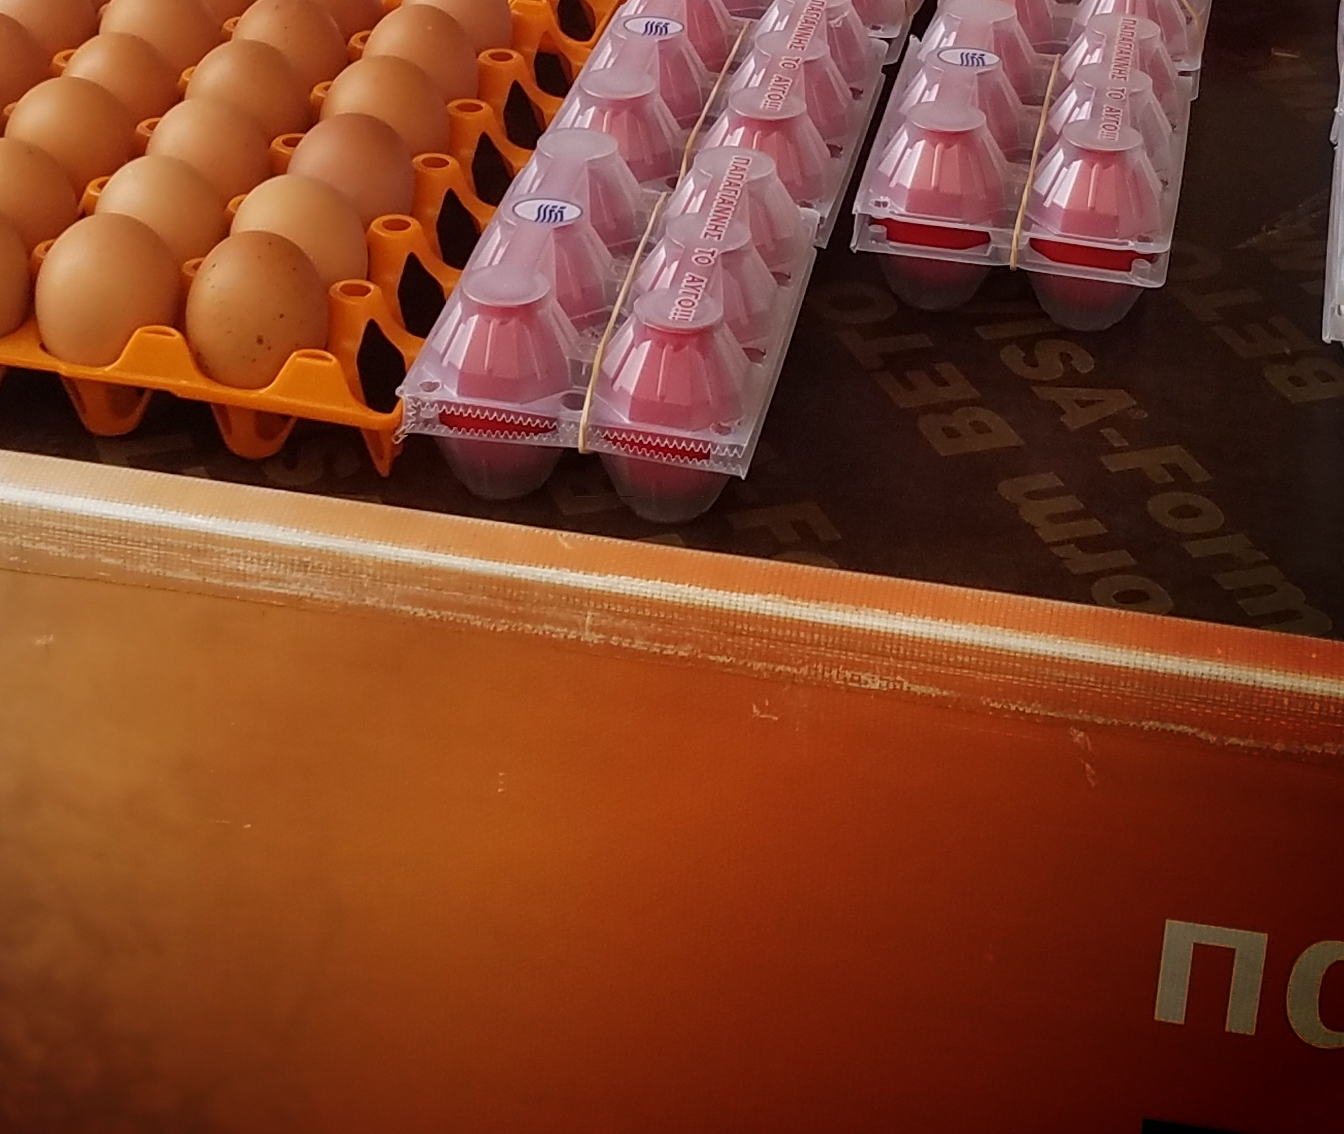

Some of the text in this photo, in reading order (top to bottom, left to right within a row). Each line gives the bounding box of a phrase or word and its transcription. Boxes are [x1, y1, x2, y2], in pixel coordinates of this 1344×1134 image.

[780, 56, 802, 70] ΤΟ
[1110, 17, 1137, 82] ΠΑΠΑΓΙΑΝΝΗΣ
[1107, 86, 1126, 100] ΤΟ
[669, 156, 751, 322] ΠΑΠΑΓΙΑΝΝΗΣ ΤΟ ΑΥΓΟ!!!
[997, 472, 1174, 617] orm
